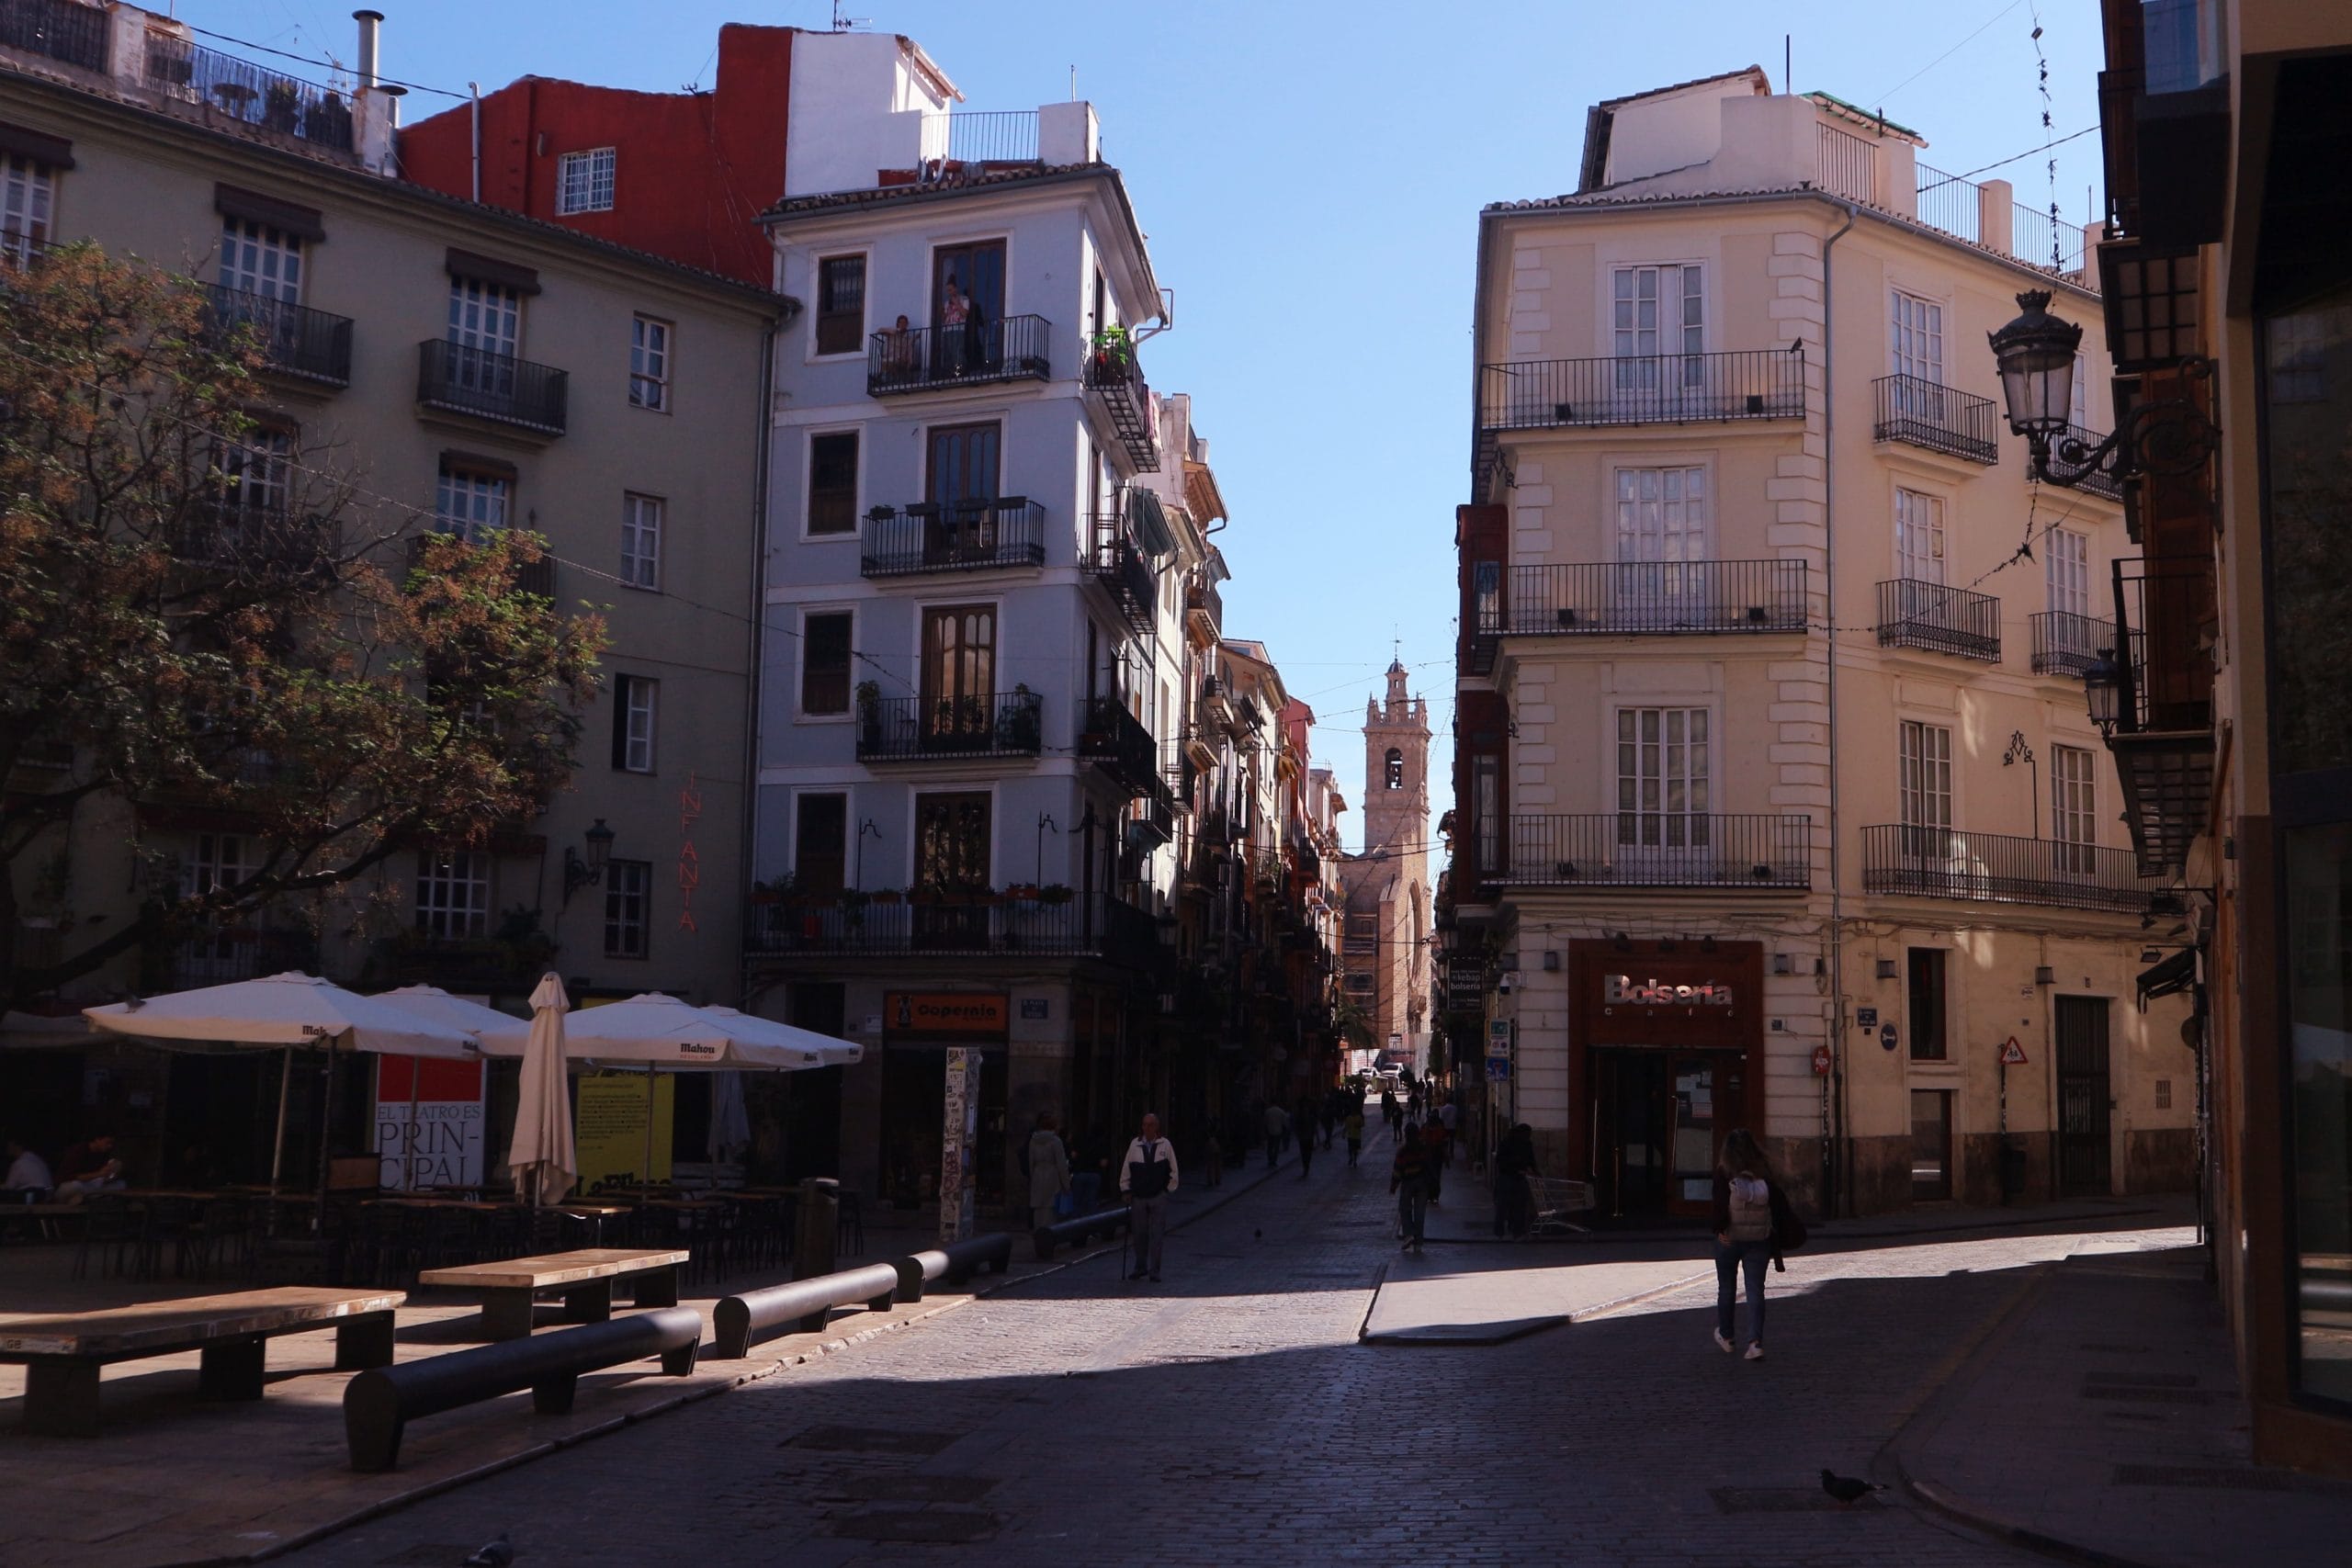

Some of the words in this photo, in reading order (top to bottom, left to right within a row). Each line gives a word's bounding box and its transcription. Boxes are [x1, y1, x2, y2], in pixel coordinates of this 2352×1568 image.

[678, 771, 702, 933] INFANTA
[1604, 974, 1733, 1005] Bolsería
[680, 1043, 715, 1054] Mahou
[378, 1106, 395, 1120] EL
[399, 1105, 459, 1120] TATRO
[463, 1105, 481, 1120] ES
[378, 1122, 479, 1155] PRIN-
